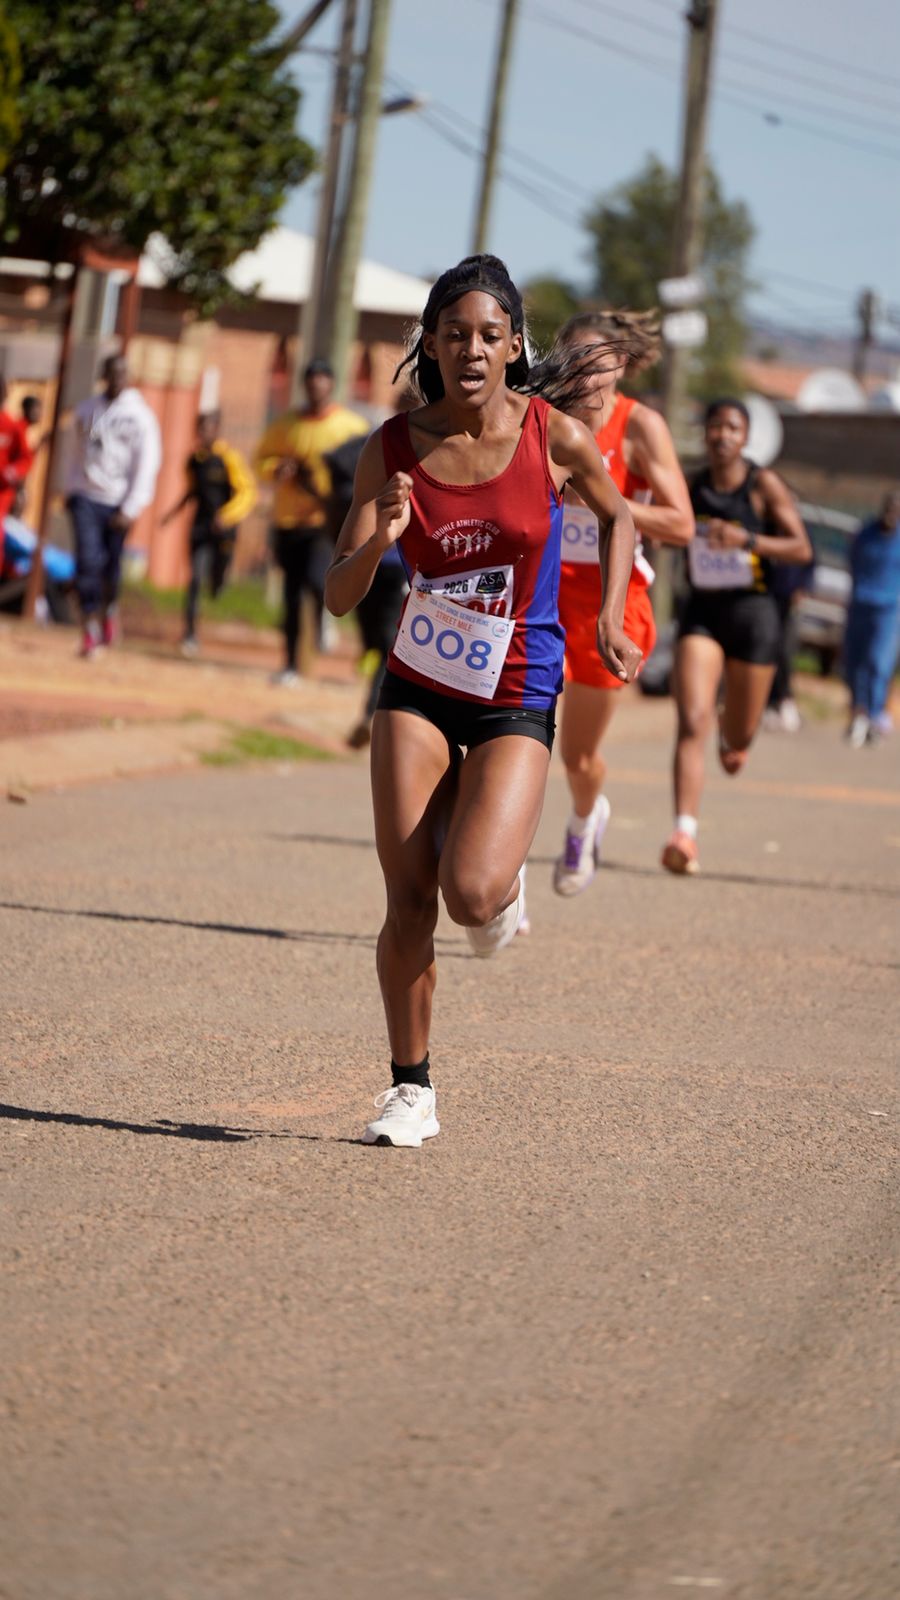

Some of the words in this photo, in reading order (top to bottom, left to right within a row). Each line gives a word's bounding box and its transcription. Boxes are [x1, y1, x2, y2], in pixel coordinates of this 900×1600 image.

[456, 518, 485, 528] ATHLETIC
[485, 521, 501, 536] CLUB
[442, 579, 469, 595] 2026
[480, 573, 505, 585] ASA
[435, 610, 457, 627] STREET
[457, 620, 473, 632] MILE
[410, 614, 493, 671] 008
